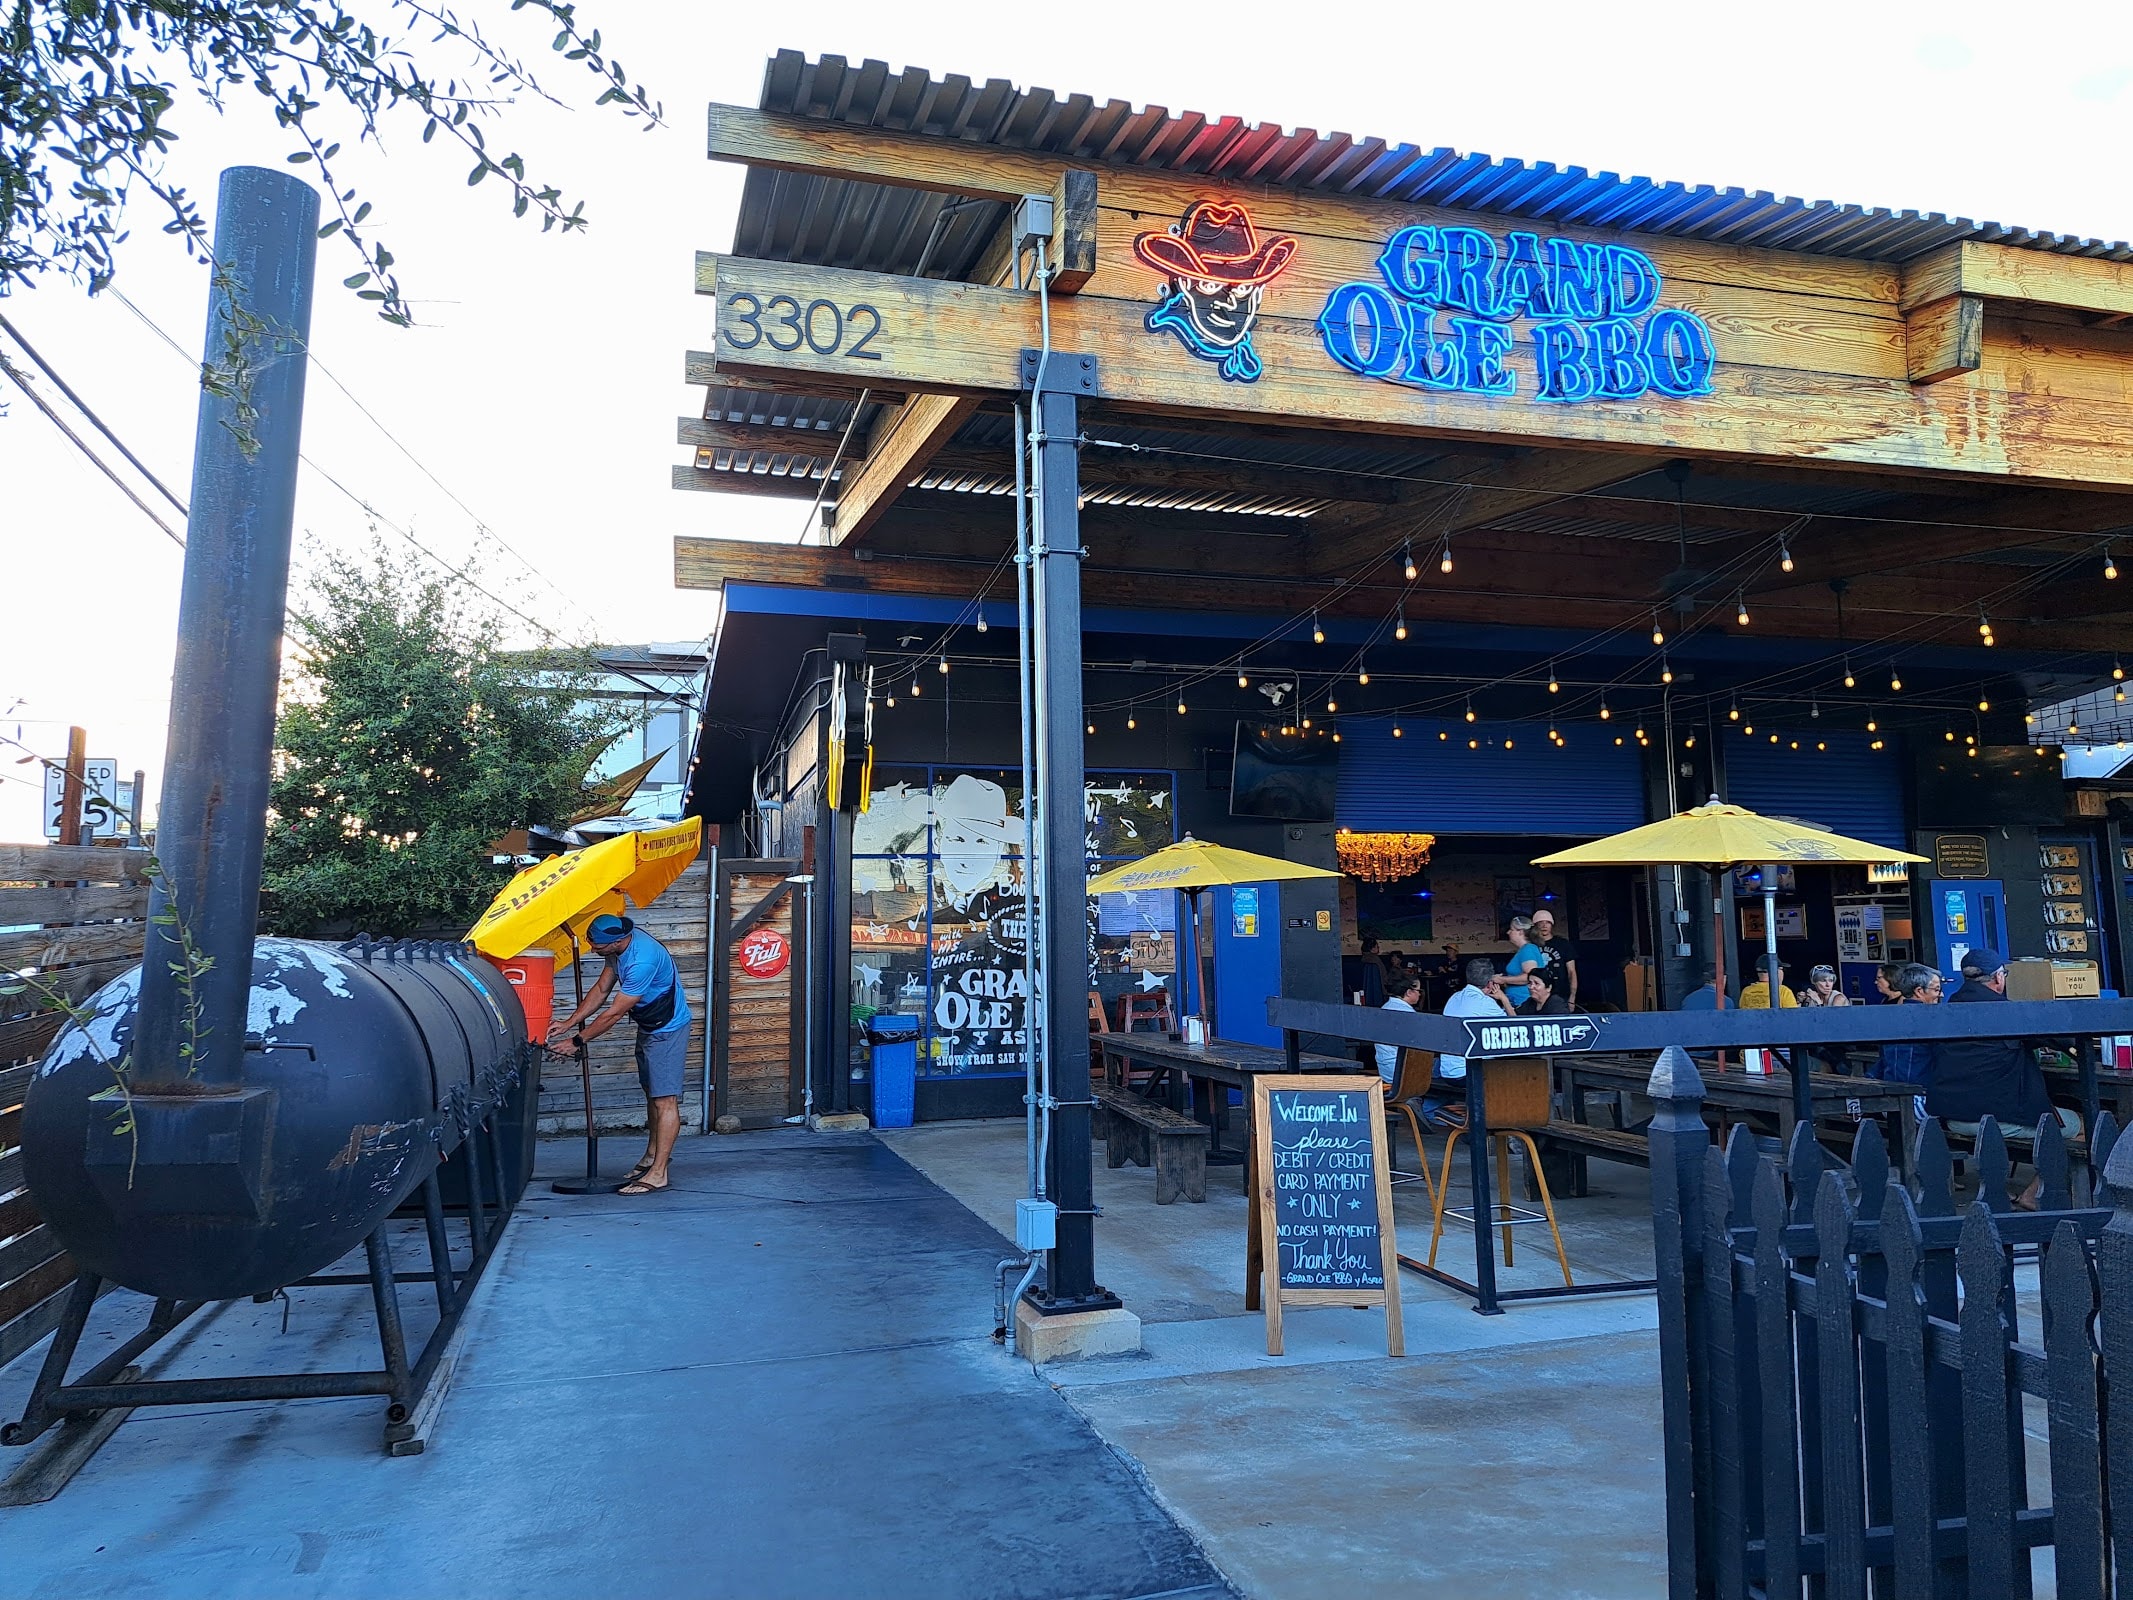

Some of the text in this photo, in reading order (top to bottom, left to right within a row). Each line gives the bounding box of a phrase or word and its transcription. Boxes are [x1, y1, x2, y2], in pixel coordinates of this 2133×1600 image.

[1375, 224, 1663, 320] GRAND
[723, 292, 882, 361] 3302
[1316, 280, 1718, 402] OLE BBQ
[51, 767, 111, 779] SED
[57, 783, 104, 795] LIT
[485, 848, 587, 927] Shiner
[1112, 865, 1199, 886] Shiner
[937, 940, 961, 955] HIS
[939, 928, 963, 941] with
[744, 941, 781, 967] Fall
[934, 991, 1013, 1030] OLE
[972, 1030, 989, 1046] Y
[1481, 1023, 1563, 1050] ORDER BBQ
[1298, 1126, 1353, 1153] please
[1273, 1151, 1313, 1169] DEBIT
[1328, 1152, 1372, 1169] CREDIT
[1277, 1172, 1370, 1190] CARD PAYMENT
[1301, 1192, 1342, 1219] ONLY
[1276, 1224, 1377, 1239] NO CASH PAYMENT!
[1279, 1237, 1373, 1271] Thank You
